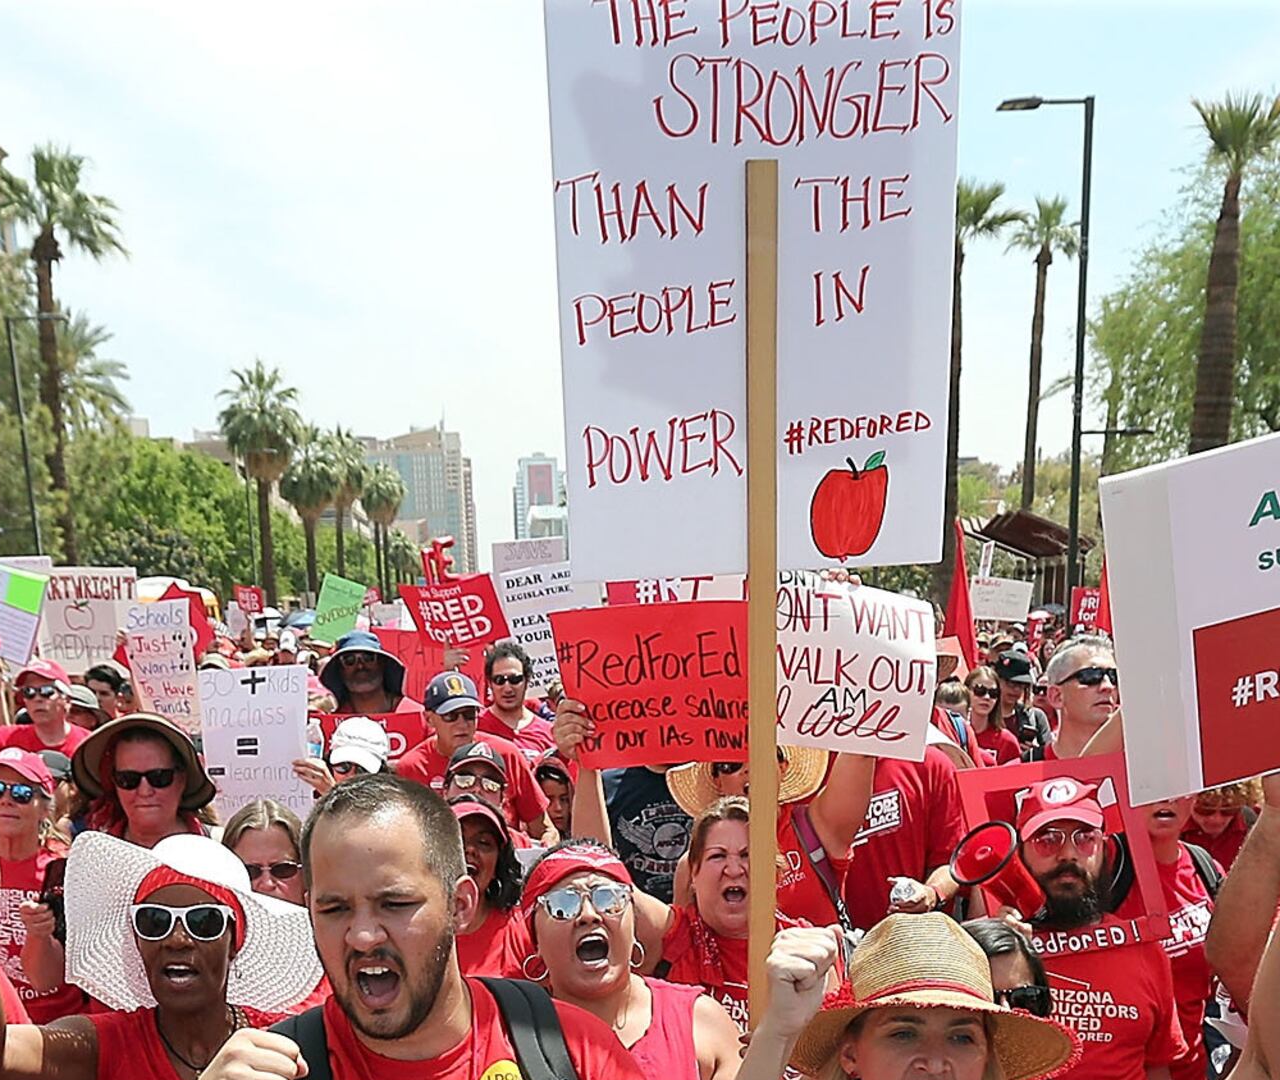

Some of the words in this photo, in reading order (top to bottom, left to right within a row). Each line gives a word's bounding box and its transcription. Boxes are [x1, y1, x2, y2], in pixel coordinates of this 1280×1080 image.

[605, 0, 697, 47] THE
[719, 0, 903, 48] PEOPLE
[924, 0, 954, 41] IS
[653, 53, 953, 147] STRONGER
[555, 171, 708, 245] THAN
[795, 174, 912, 234] THE
[573, 278, 737, 346] PEOPLE
[814, 265, 870, 326] IN
[784, 410, 932, 455] #REDFORED
[583, 408, 743, 489] POWER
[47, 575, 135, 600] RTWRIGHT
[506, 573, 543, 590] DEAR
[127, 604, 184, 629] Schools
[419, 594, 484, 622] #RED
[512, 613, 551, 628] PLEAS
[852, 594, 930, 643] WANT
[425, 615, 492, 643] forED
[515, 630, 553, 645] YOUR
[132, 634, 170, 652] Just
[557, 626, 740, 690] #RedForEd
[616, 730, 646, 750] our
[869, 811, 900, 828] BACK
[1050, 987, 1114, 1005] RIZONA
[1050, 1003, 1139, 1020] DUCATORS
